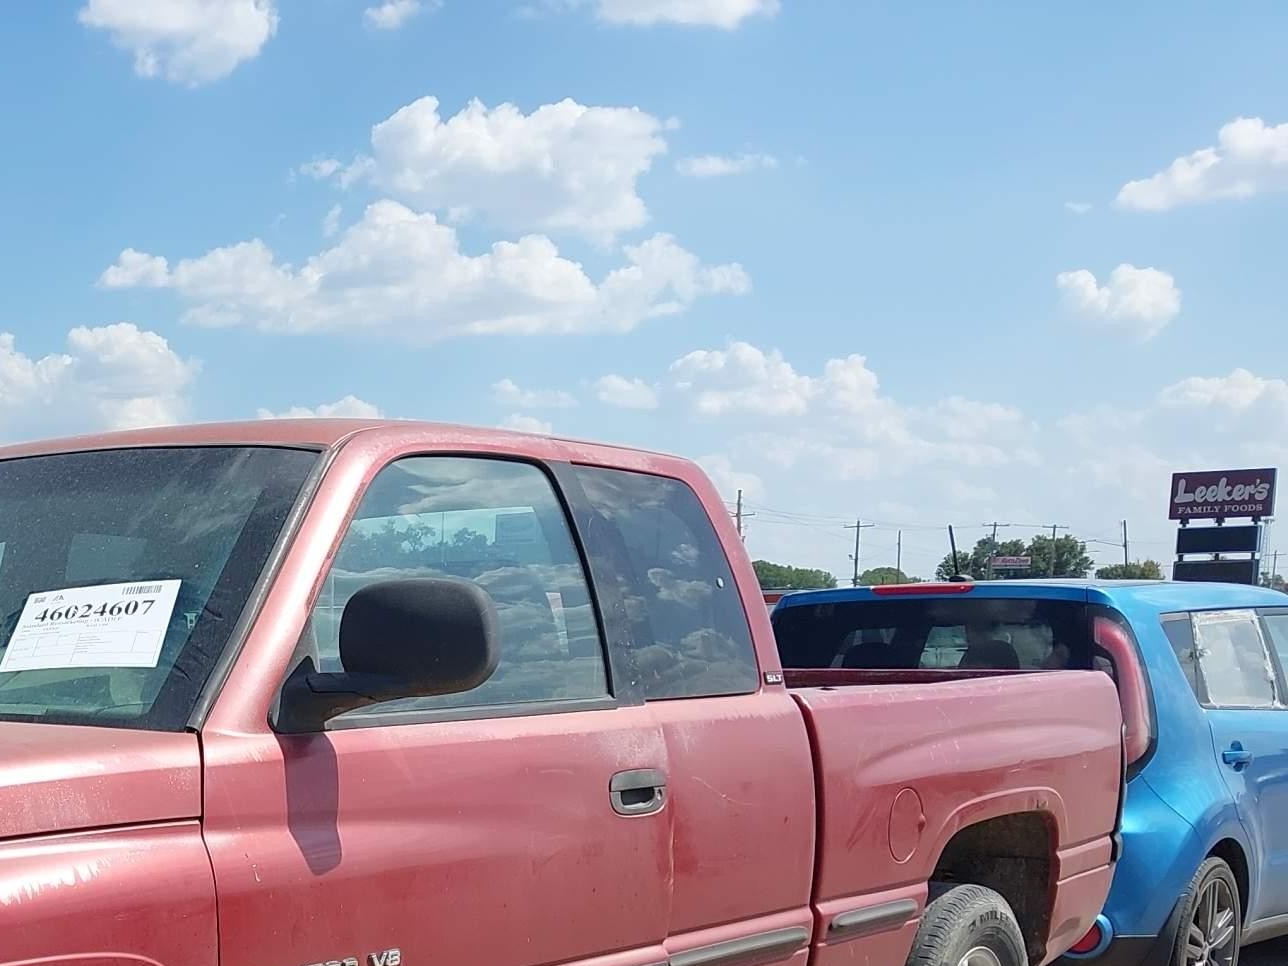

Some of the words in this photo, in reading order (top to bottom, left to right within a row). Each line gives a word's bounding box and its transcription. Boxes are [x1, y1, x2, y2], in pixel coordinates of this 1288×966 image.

[1174, 477, 1270, 503] Leeker's
[1178, 505, 1221, 514] FAMILY
[1224, 503, 1263, 512] FOODS
[35, 600, 156, 622] 46024607
[766, 673, 782, 683] SLT
